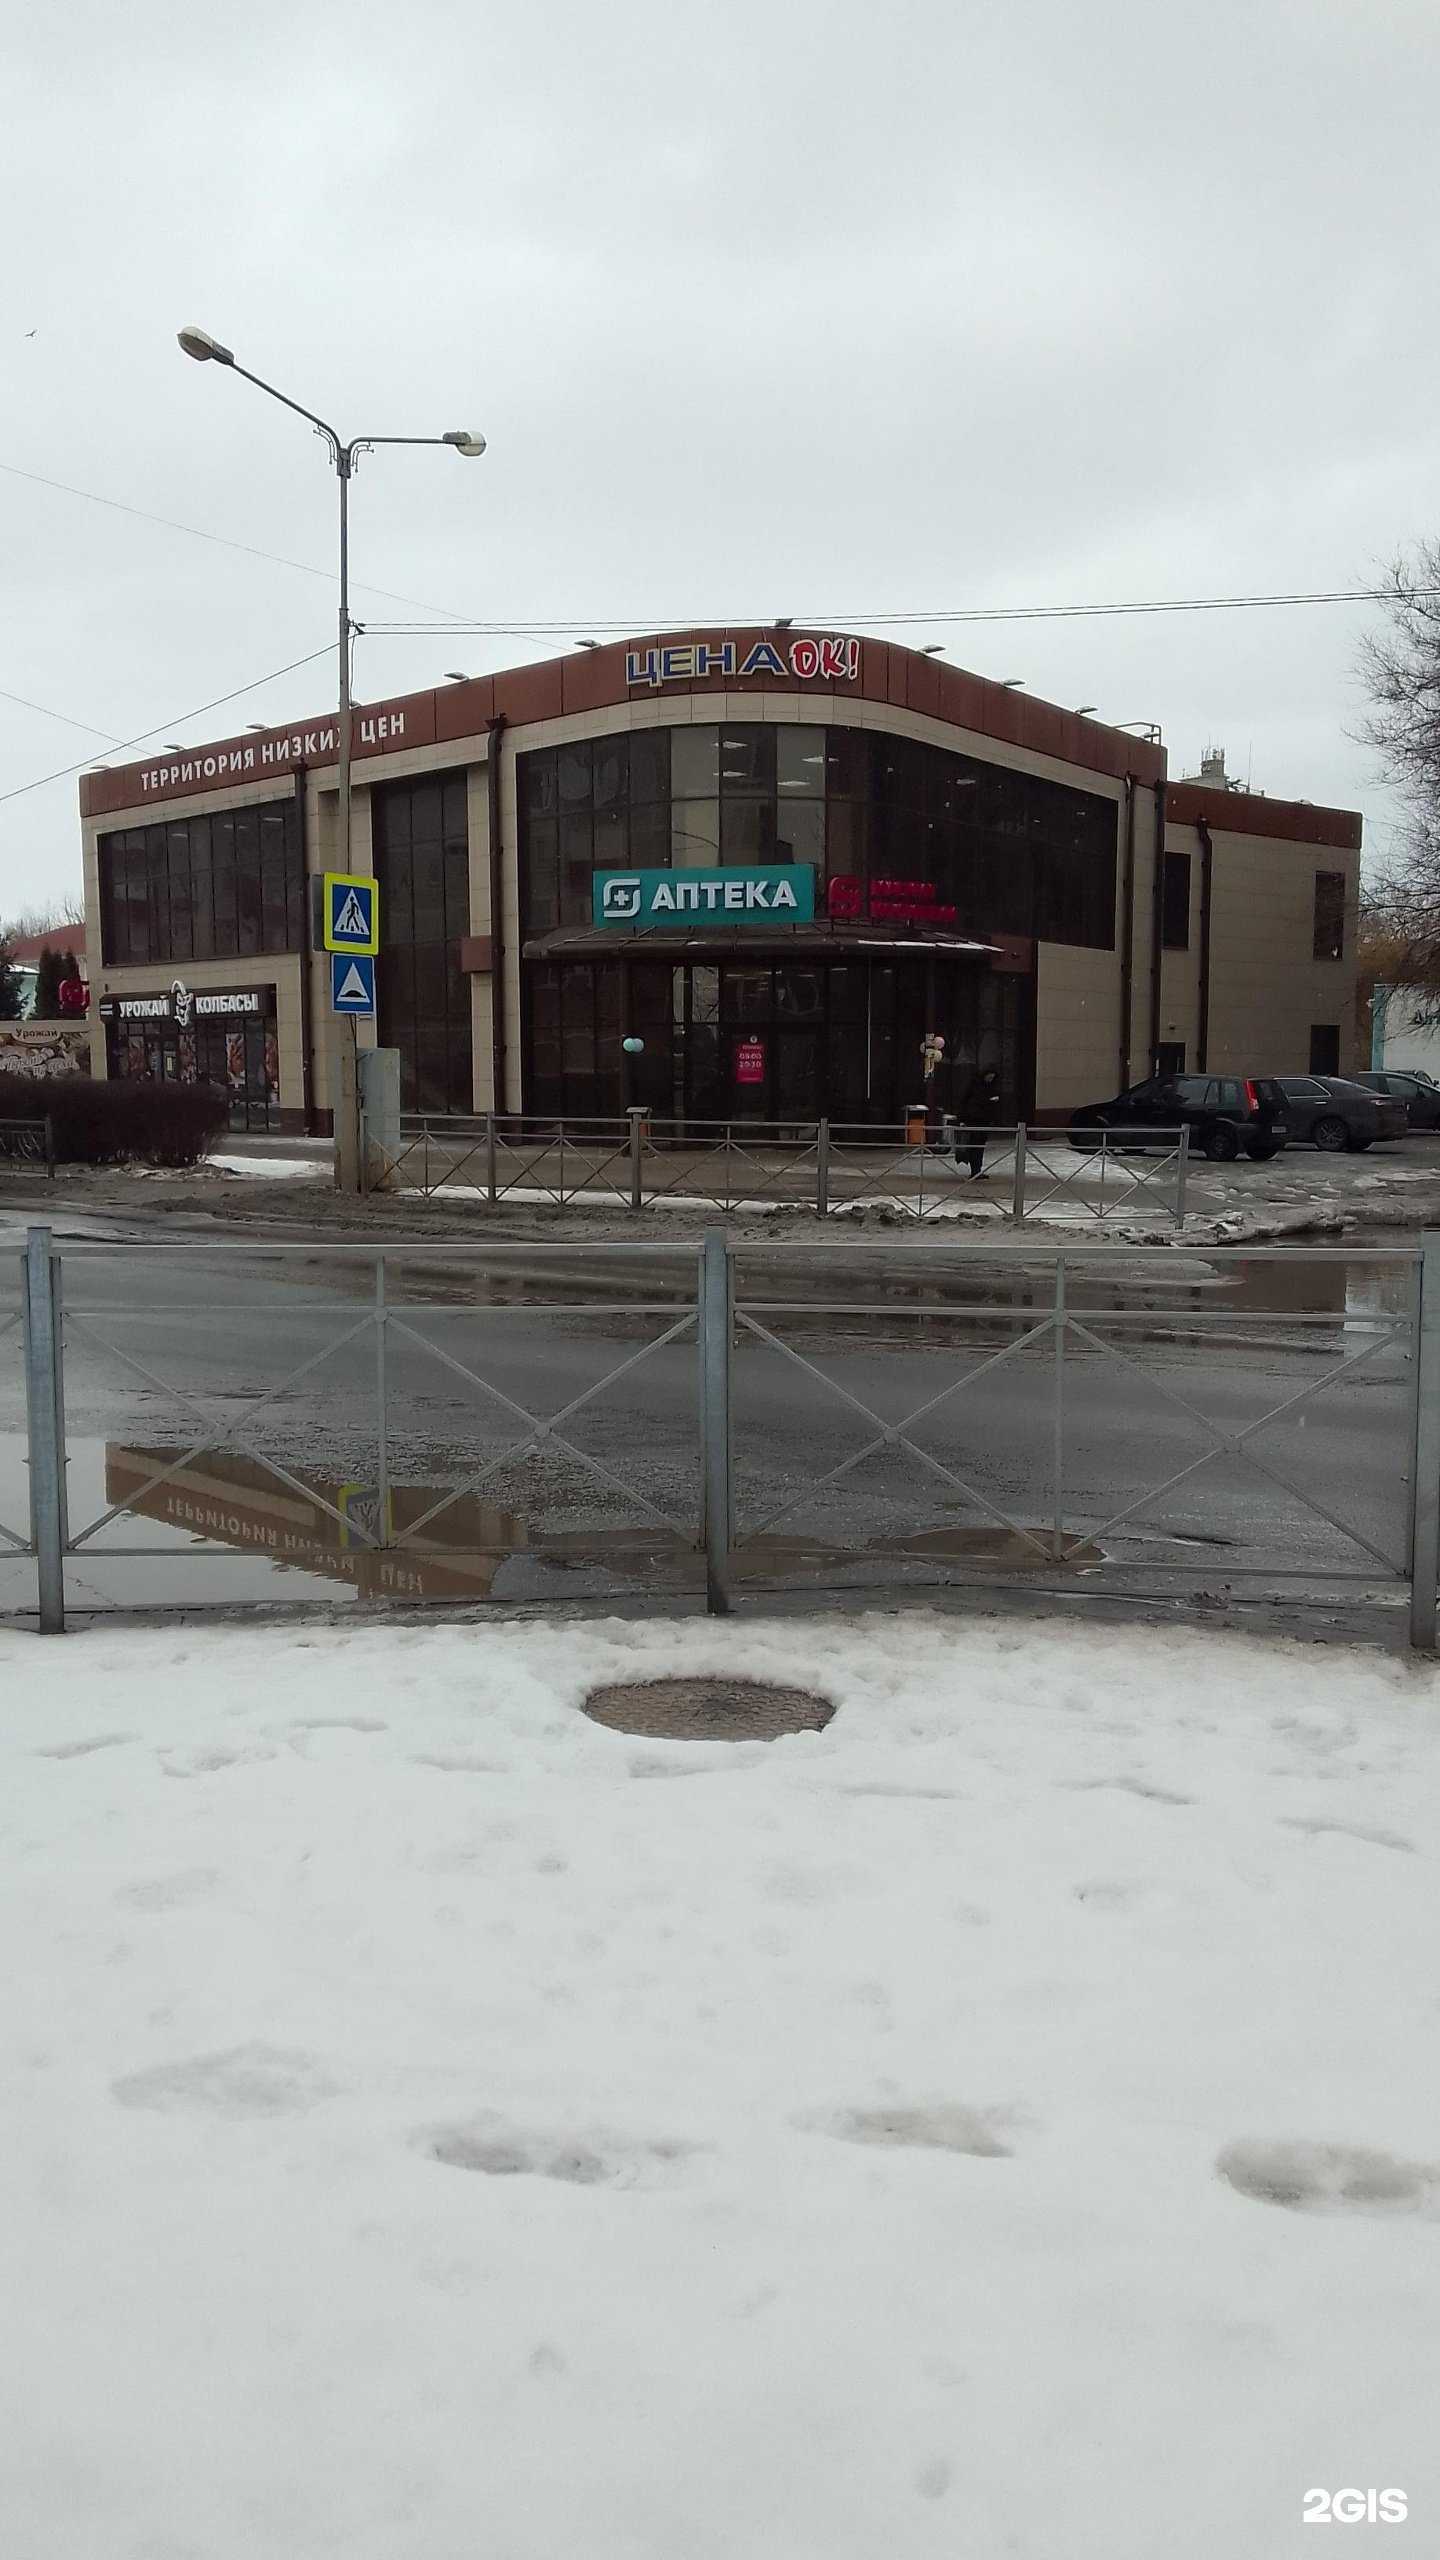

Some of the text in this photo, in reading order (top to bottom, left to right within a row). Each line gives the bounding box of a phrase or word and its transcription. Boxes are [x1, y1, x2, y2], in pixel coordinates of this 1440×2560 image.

[626, 641, 789, 688] ЦЕНА
[140, 712, 405, 791] ТЕРРИТОРИЯ НИЗКИ ЦЕН
[650, 880, 798, 911] АПТЕКА
[118, 993, 259, 1018] УРОЖАЙ КОЛБАСЫ
